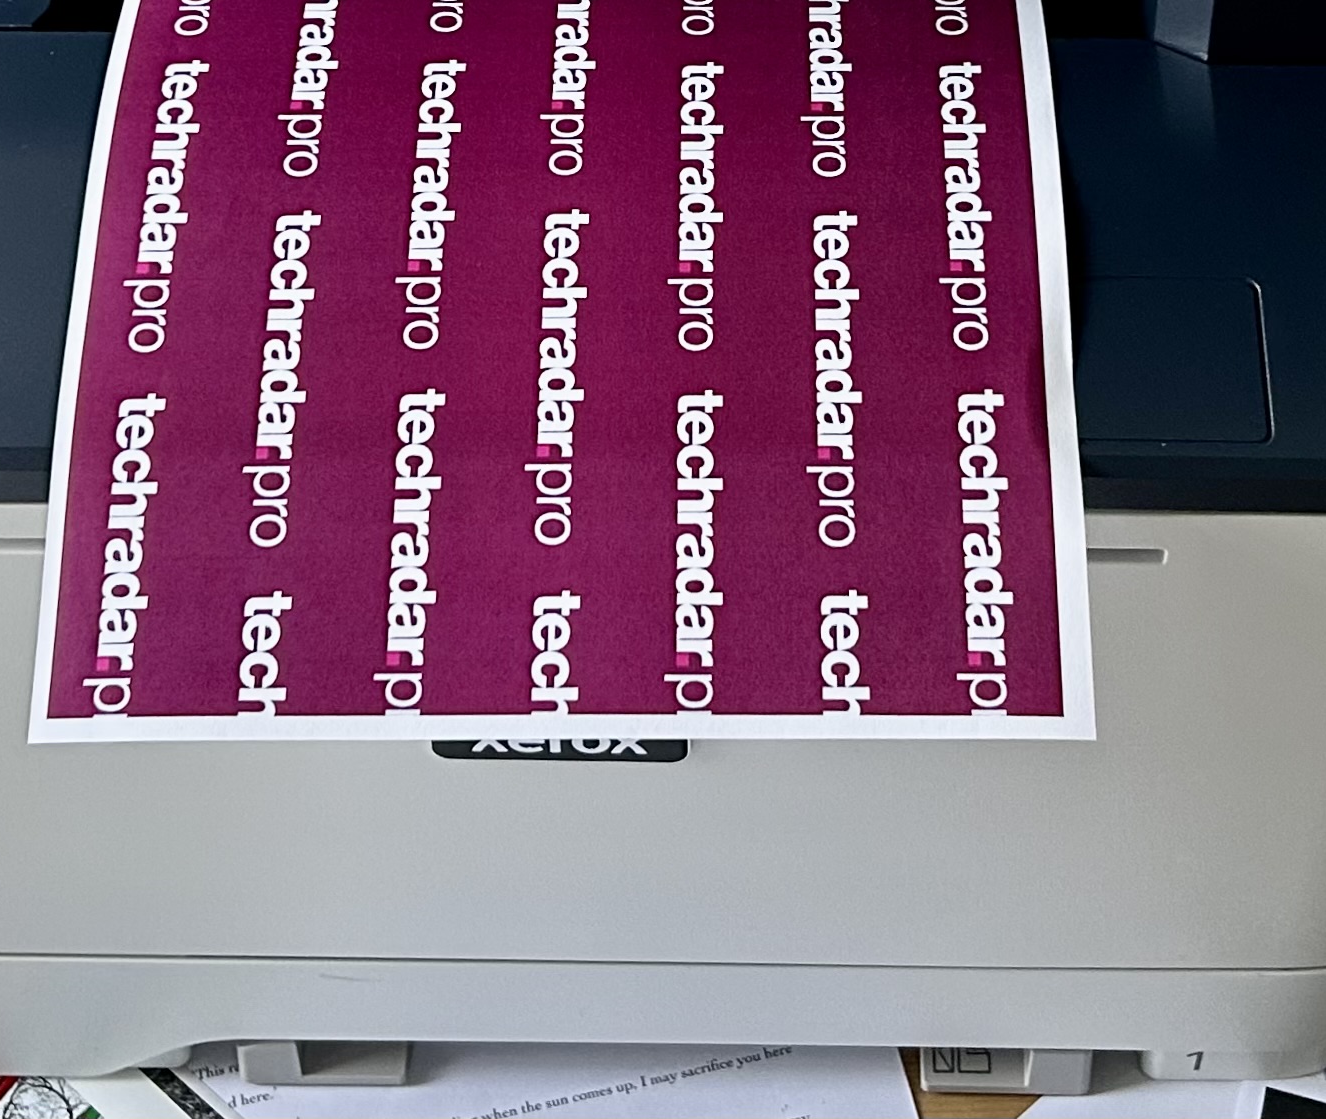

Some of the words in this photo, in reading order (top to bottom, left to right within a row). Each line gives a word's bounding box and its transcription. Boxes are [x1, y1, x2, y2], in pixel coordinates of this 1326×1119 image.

[123, 60, 210, 353] techradar.pro
[395, 59, 467, 350] techradar.pro
[667, 62, 724, 351] techradar.pro
[939, 62, 992, 351] techradar.pro
[242, 210, 321, 547] techradar.pro
[524, 209, 590, 545] techradar.pro
[806, 210, 863, 547] techradar.pro
[83, 393, 166, 715] techradar.p
[373, 388, 446, 714] techradar.p
[664, 389, 723, 714] techradar.p
[956, 389, 1010, 714] techradar.p
[521, 1101, 543, 1114] the
[545, 1095, 569, 1109] sun
[572, 1087, 614, 1103] comes
[616, 1081, 638, 1096] up,
[640, 1074, 649, 1088] I
[650, 1070, 679, 1086] may
[680, 1057, 735, 1079] sacrifice
[735, 1053, 762, 1070] you
[763, 1044, 793, 1060] here
[1186, 1051, 1205, 1071] 1
